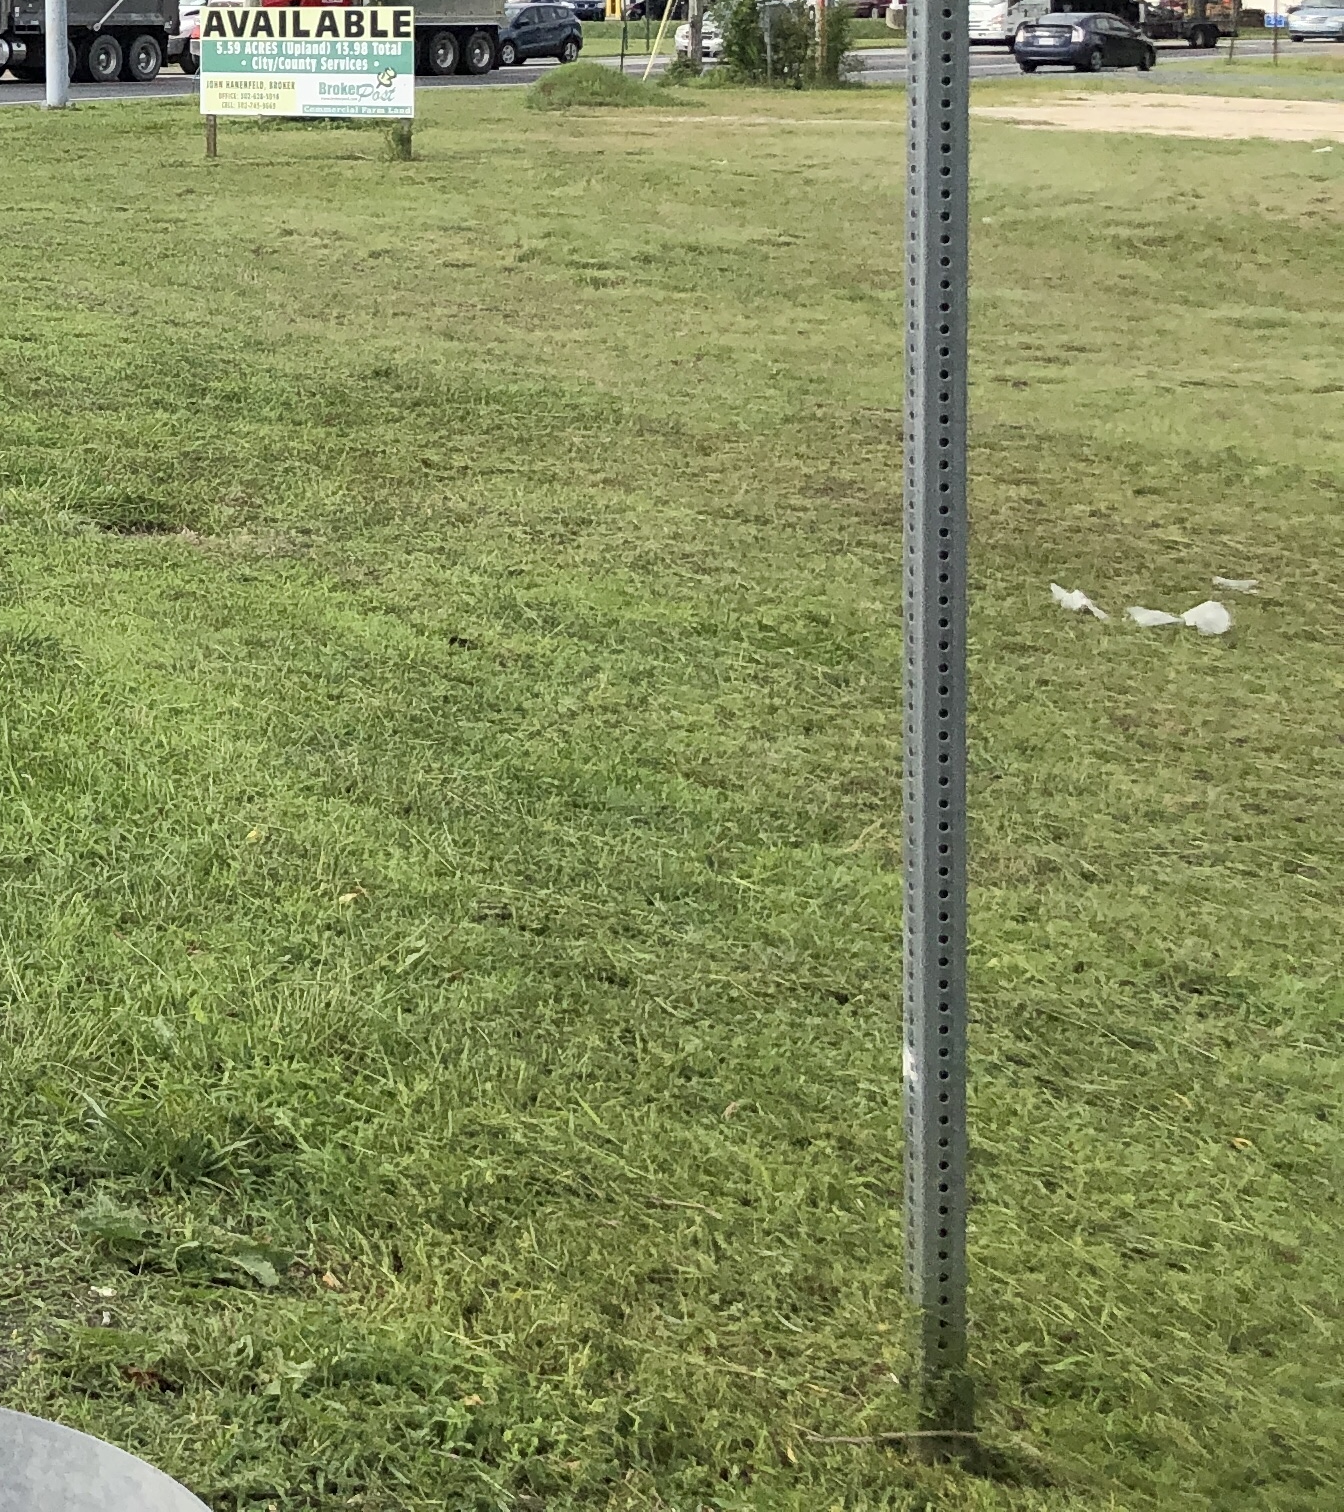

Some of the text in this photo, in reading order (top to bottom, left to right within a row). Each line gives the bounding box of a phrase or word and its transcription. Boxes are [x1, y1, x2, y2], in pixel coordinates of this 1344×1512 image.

[202, 9, 412, 38] AVAILABLE
[216, 41, 402, 57] 5.59 ACRES (Upland) 13.98 Total
[251, 56, 368, 72] City/County Services
[206, 80, 224, 89] JOHN
[269, 81, 296, 90] BROKER
[318, 81, 397, 103] Broker Post
[303, 104, 412, 115] Commercial Farm Land
